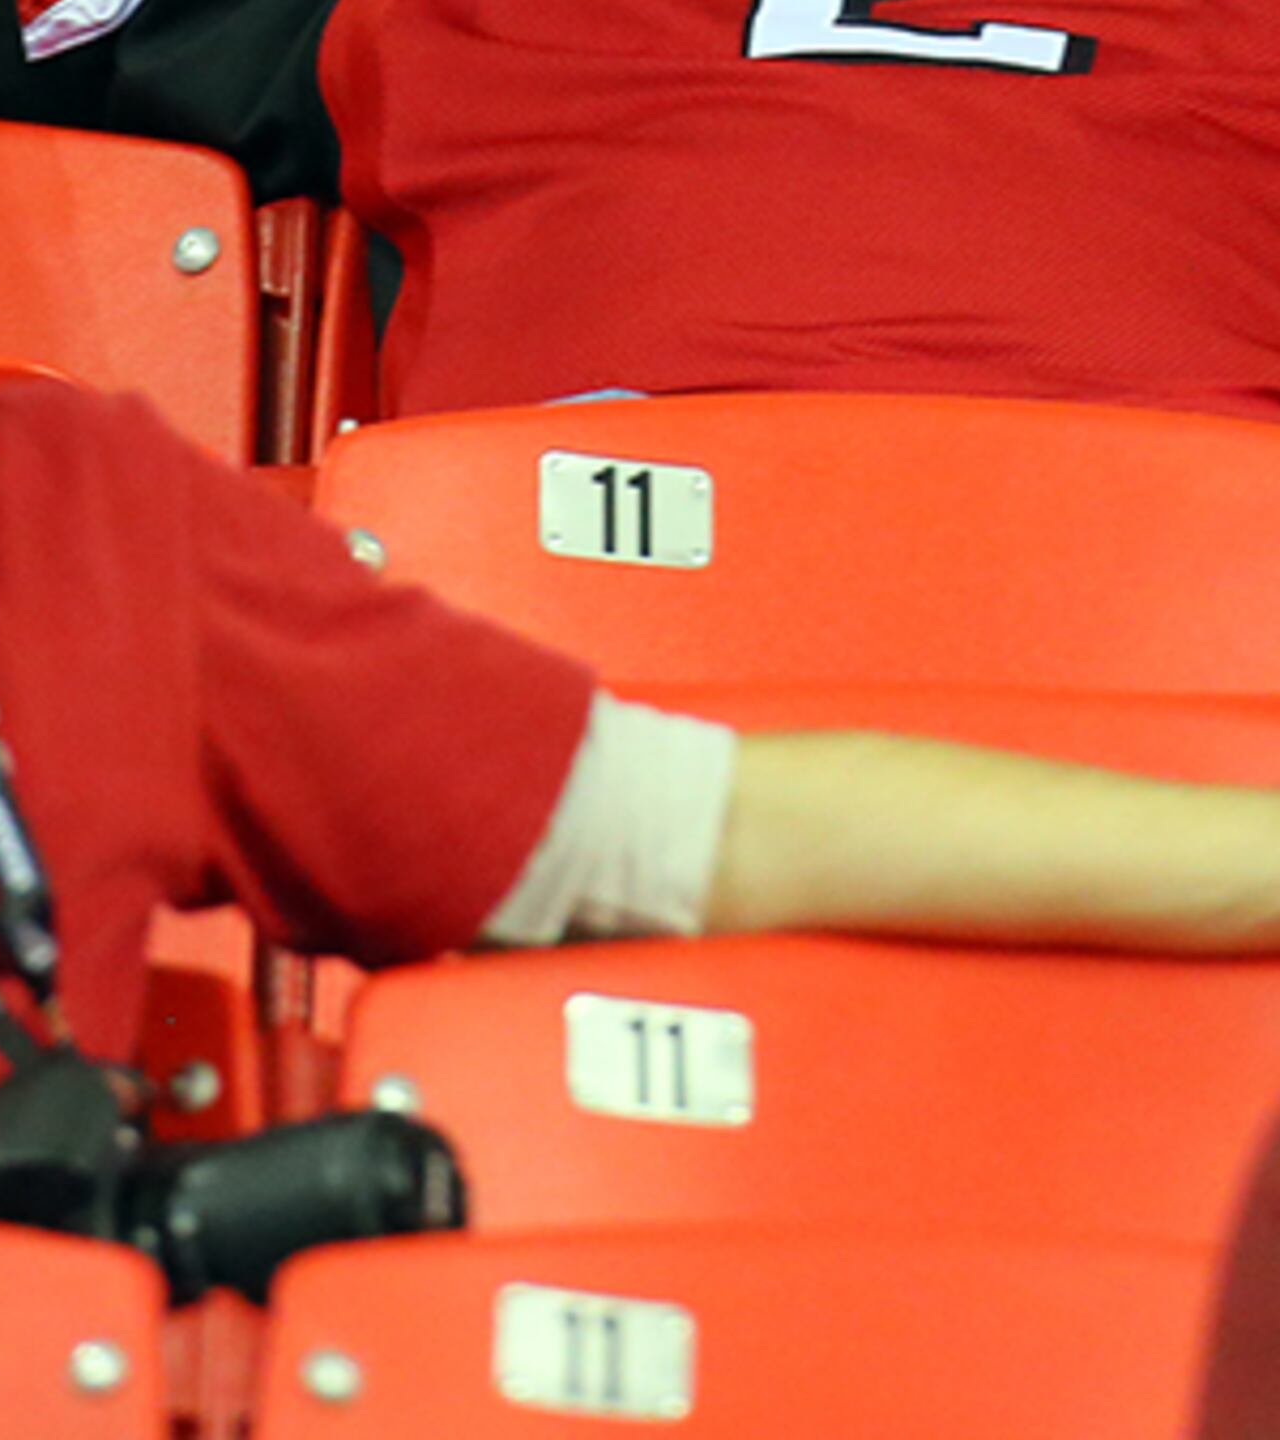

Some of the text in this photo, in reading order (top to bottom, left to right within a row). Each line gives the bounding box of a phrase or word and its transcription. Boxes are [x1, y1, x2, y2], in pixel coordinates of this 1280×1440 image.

[591, 466, 652, 559] 11
[627, 1018, 688, 1111] 11
[562, 1308, 623, 1405] 11
